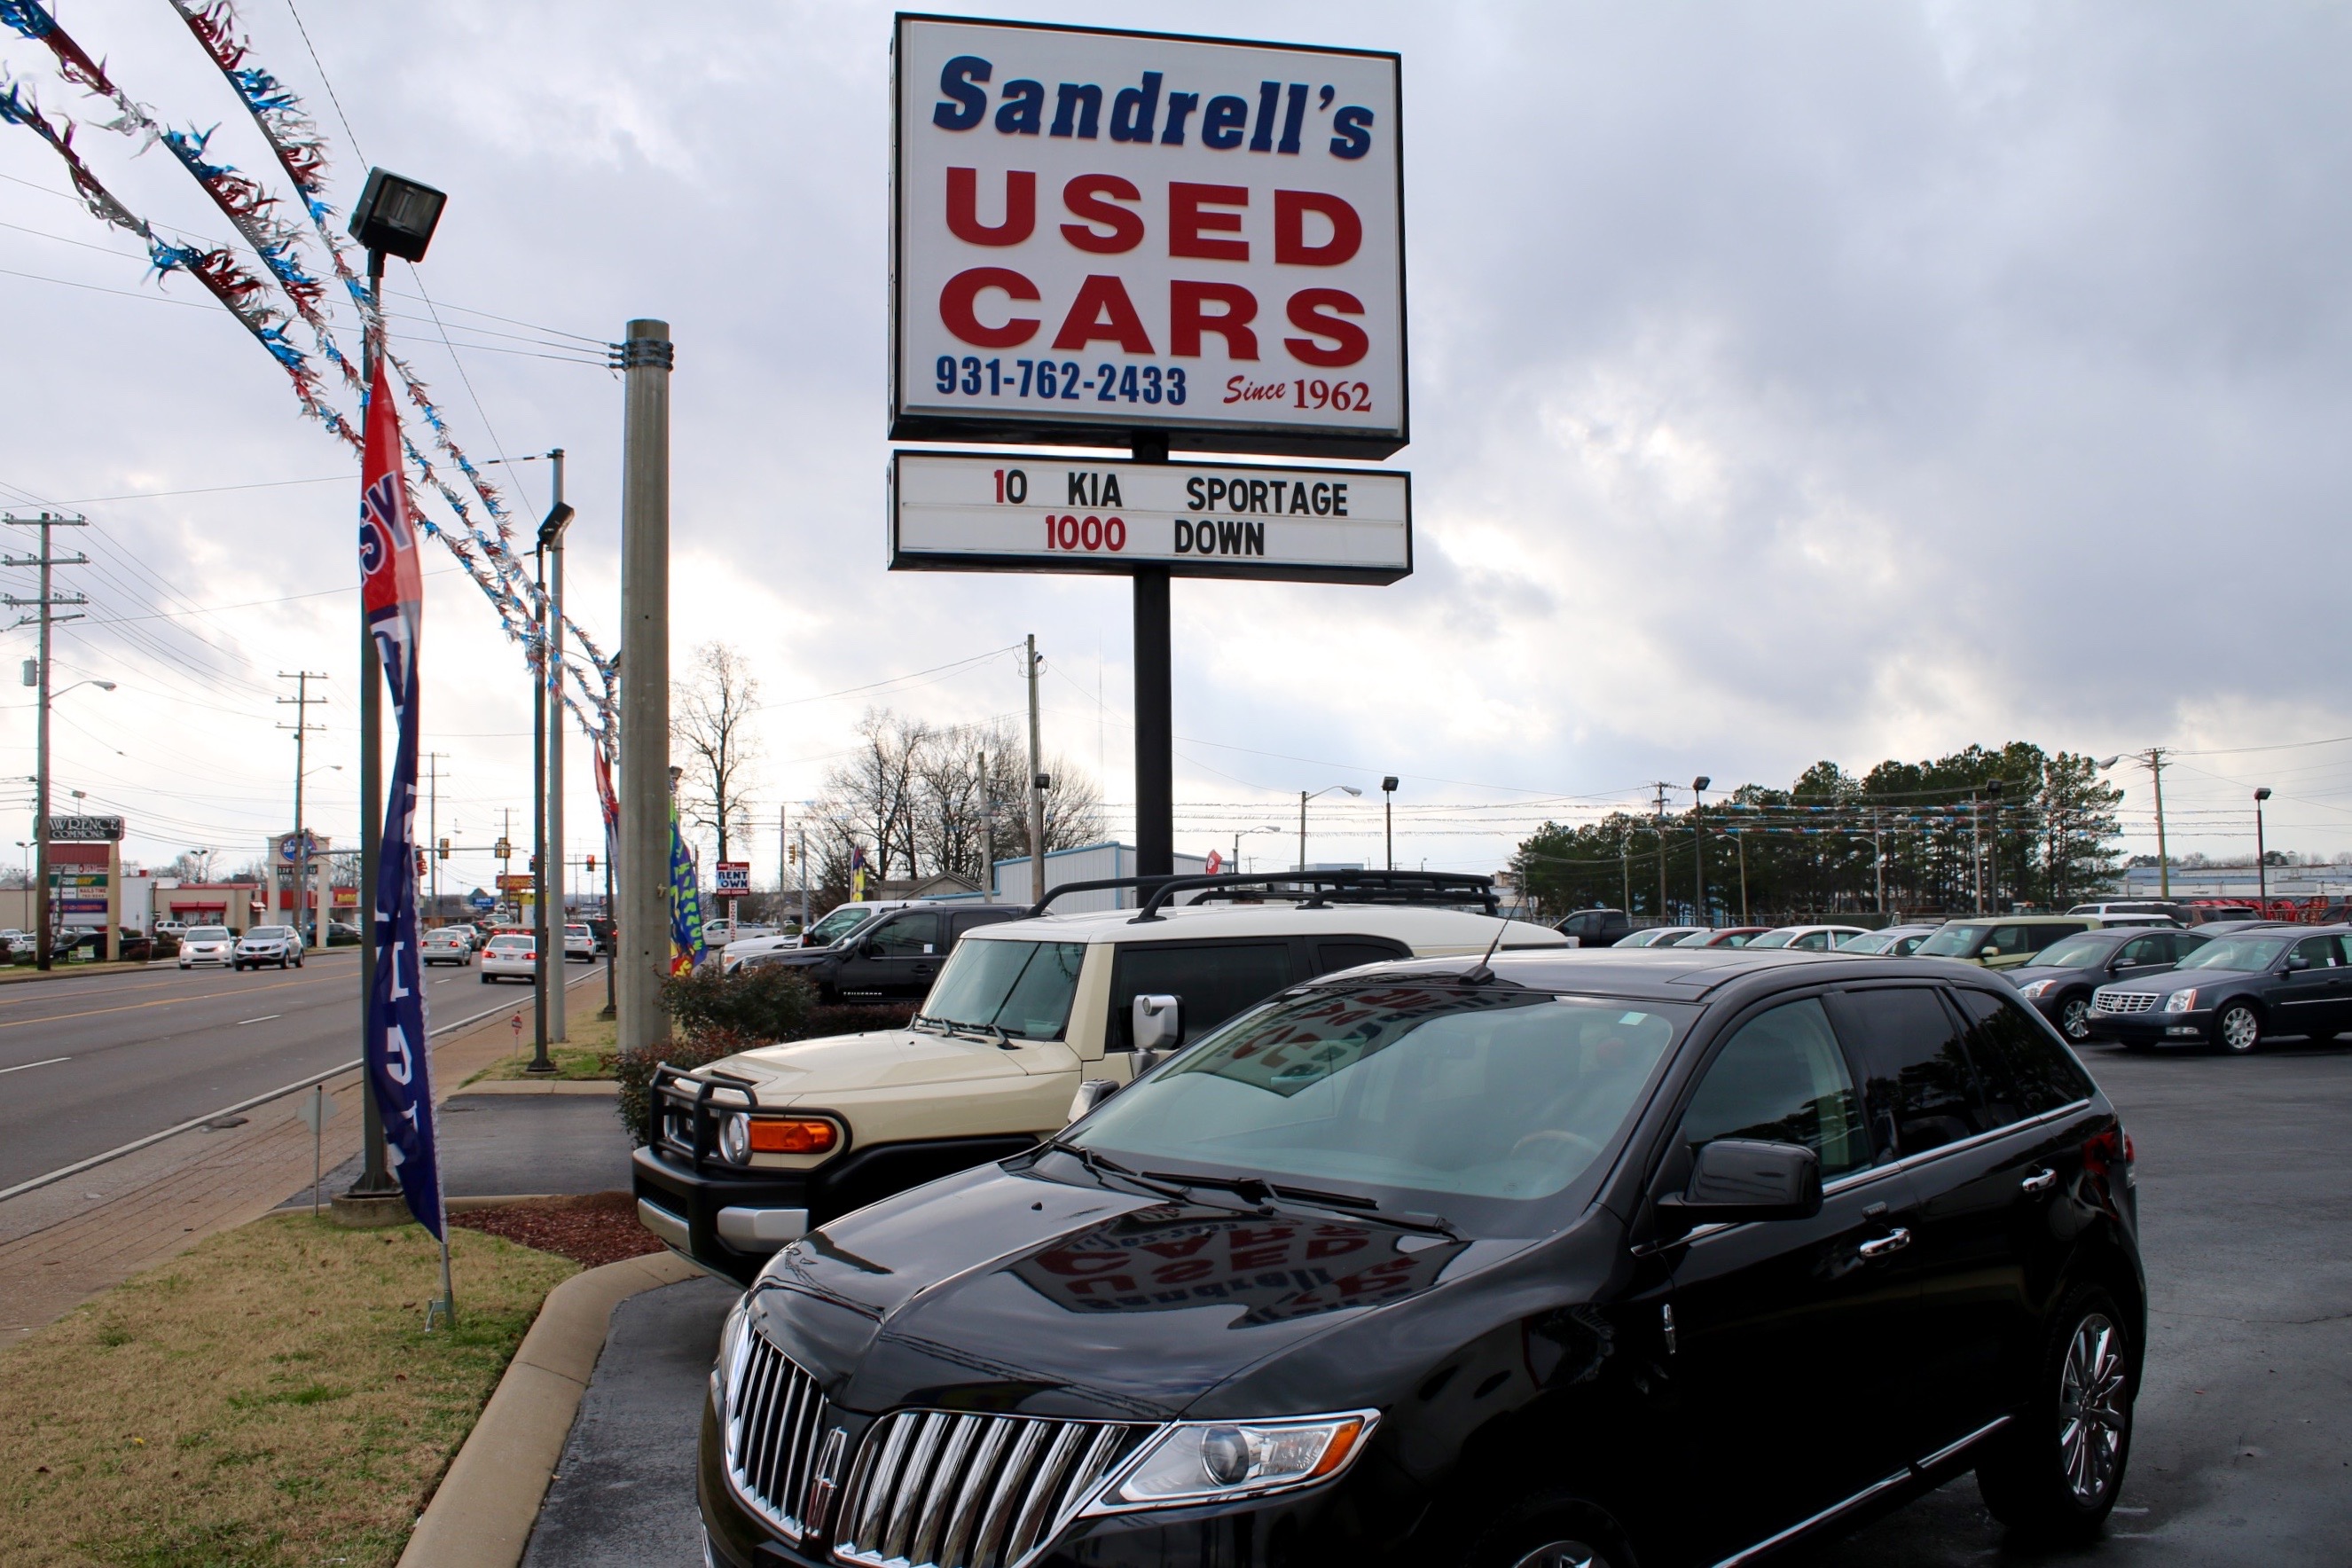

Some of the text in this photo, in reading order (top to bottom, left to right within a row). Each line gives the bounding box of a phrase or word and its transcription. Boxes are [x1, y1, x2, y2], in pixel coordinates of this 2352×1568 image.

[932, 55, 1375, 160] Sandrell's
[945, 166, 1362, 267] USED
[939, 266, 1369, 368] CARS
[936, 355, 1373, 413] 931-762-2433 Since 1962
[993, 469, 1348, 517] 10 KIA SPORTAGE
[1045, 514, 1265, 557] 1000 DOWN
[50, 819, 118, 830] AWRENCE
[718, 871, 748, 880] RENT
